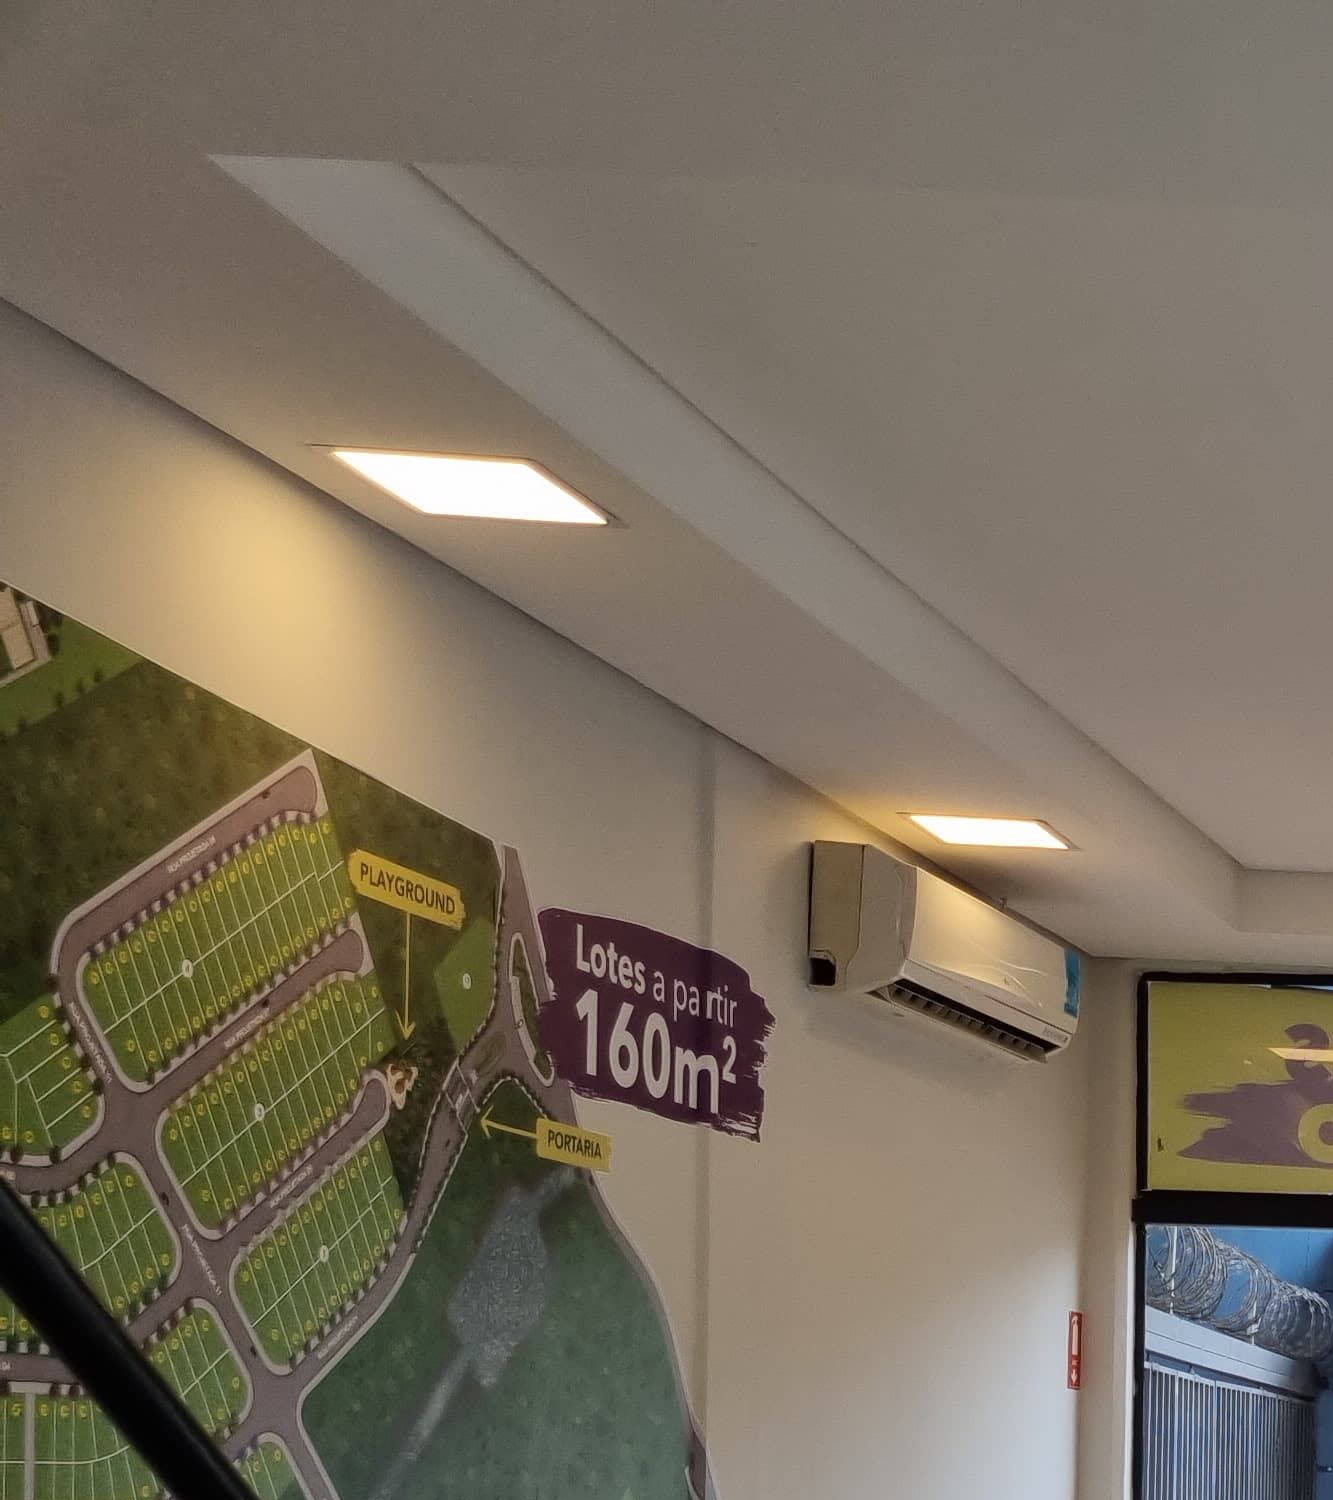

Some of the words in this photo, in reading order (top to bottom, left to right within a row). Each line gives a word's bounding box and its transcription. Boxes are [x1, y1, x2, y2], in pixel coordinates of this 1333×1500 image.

[360, 861, 456, 915] PLAYGROUND
[576, 924, 646, 994] Lotes
[653, 970, 666, 1003] a
[673, 979, 738, 1028] partir
[547, 1129, 603, 1159] PORTARIA
